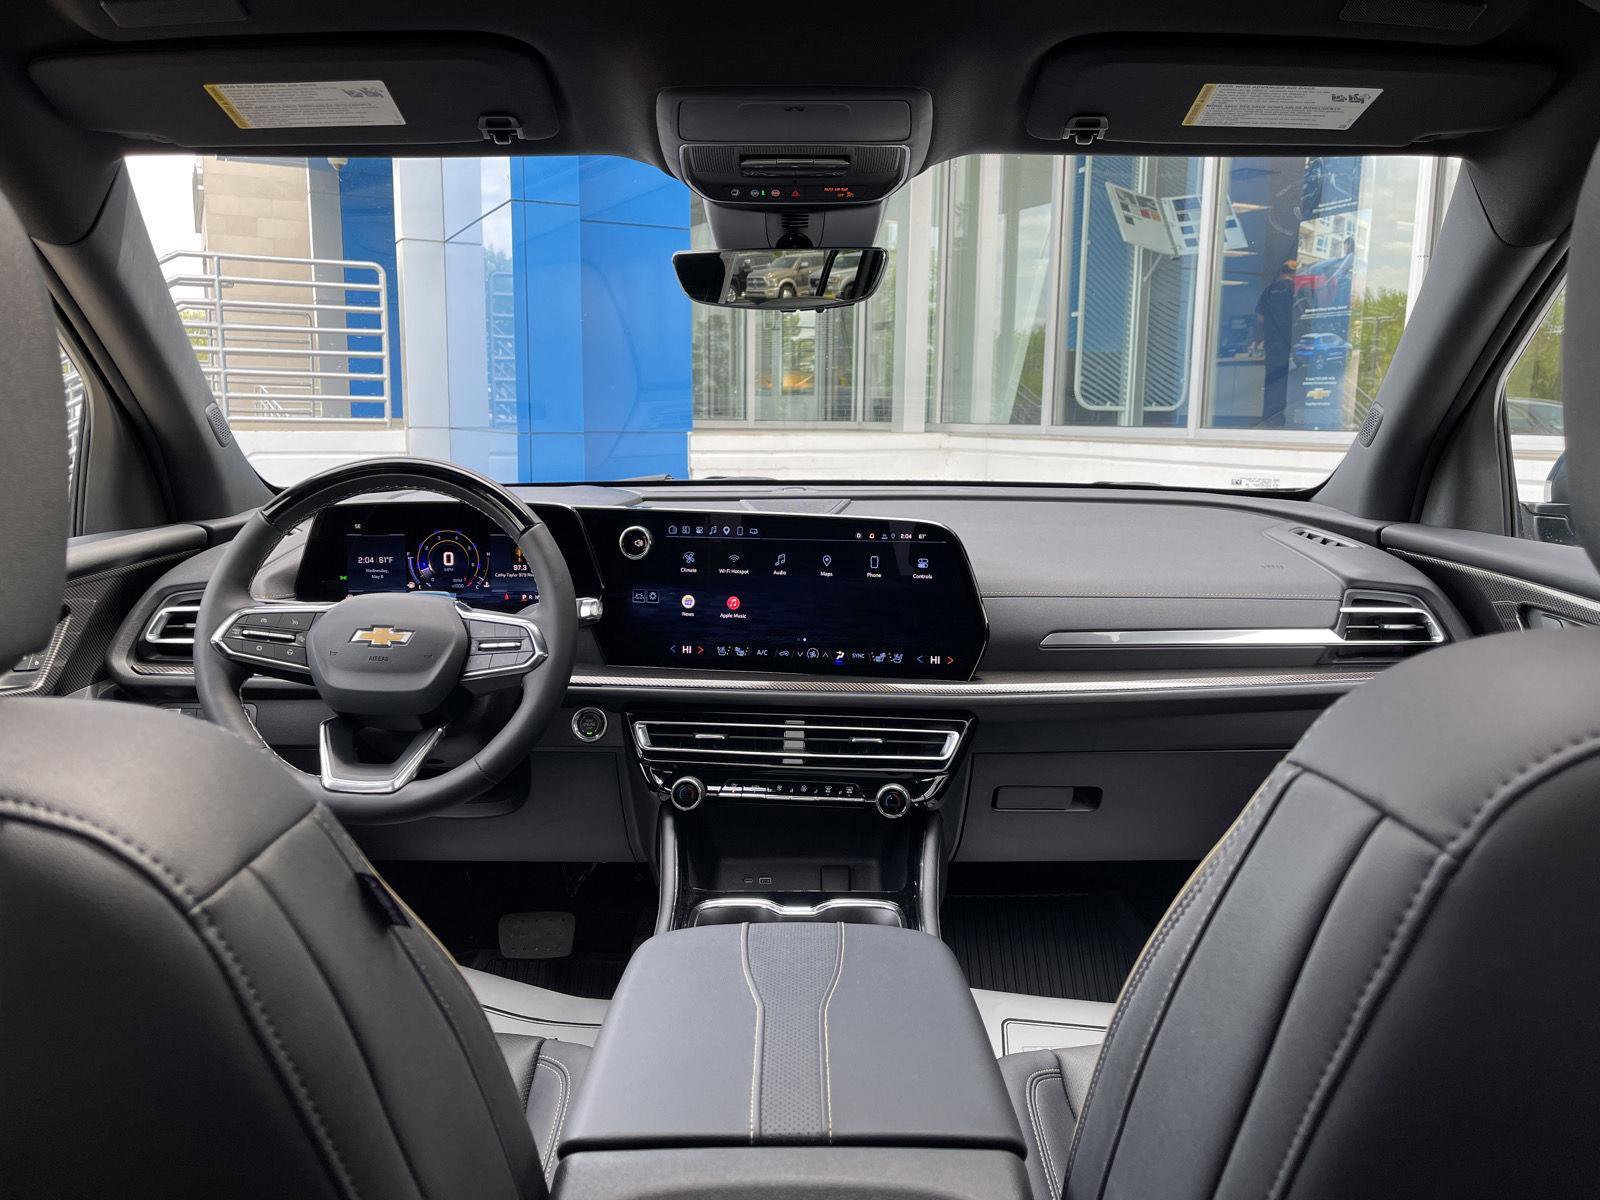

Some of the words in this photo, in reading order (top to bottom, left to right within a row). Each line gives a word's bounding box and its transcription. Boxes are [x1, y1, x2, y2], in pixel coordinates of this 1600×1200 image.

[357, 556, 374, 564] 2:04
[443, 551, 454, 566] 0
[682, 645, 692, 654] HI
[930, 655, 941, 665] HI
